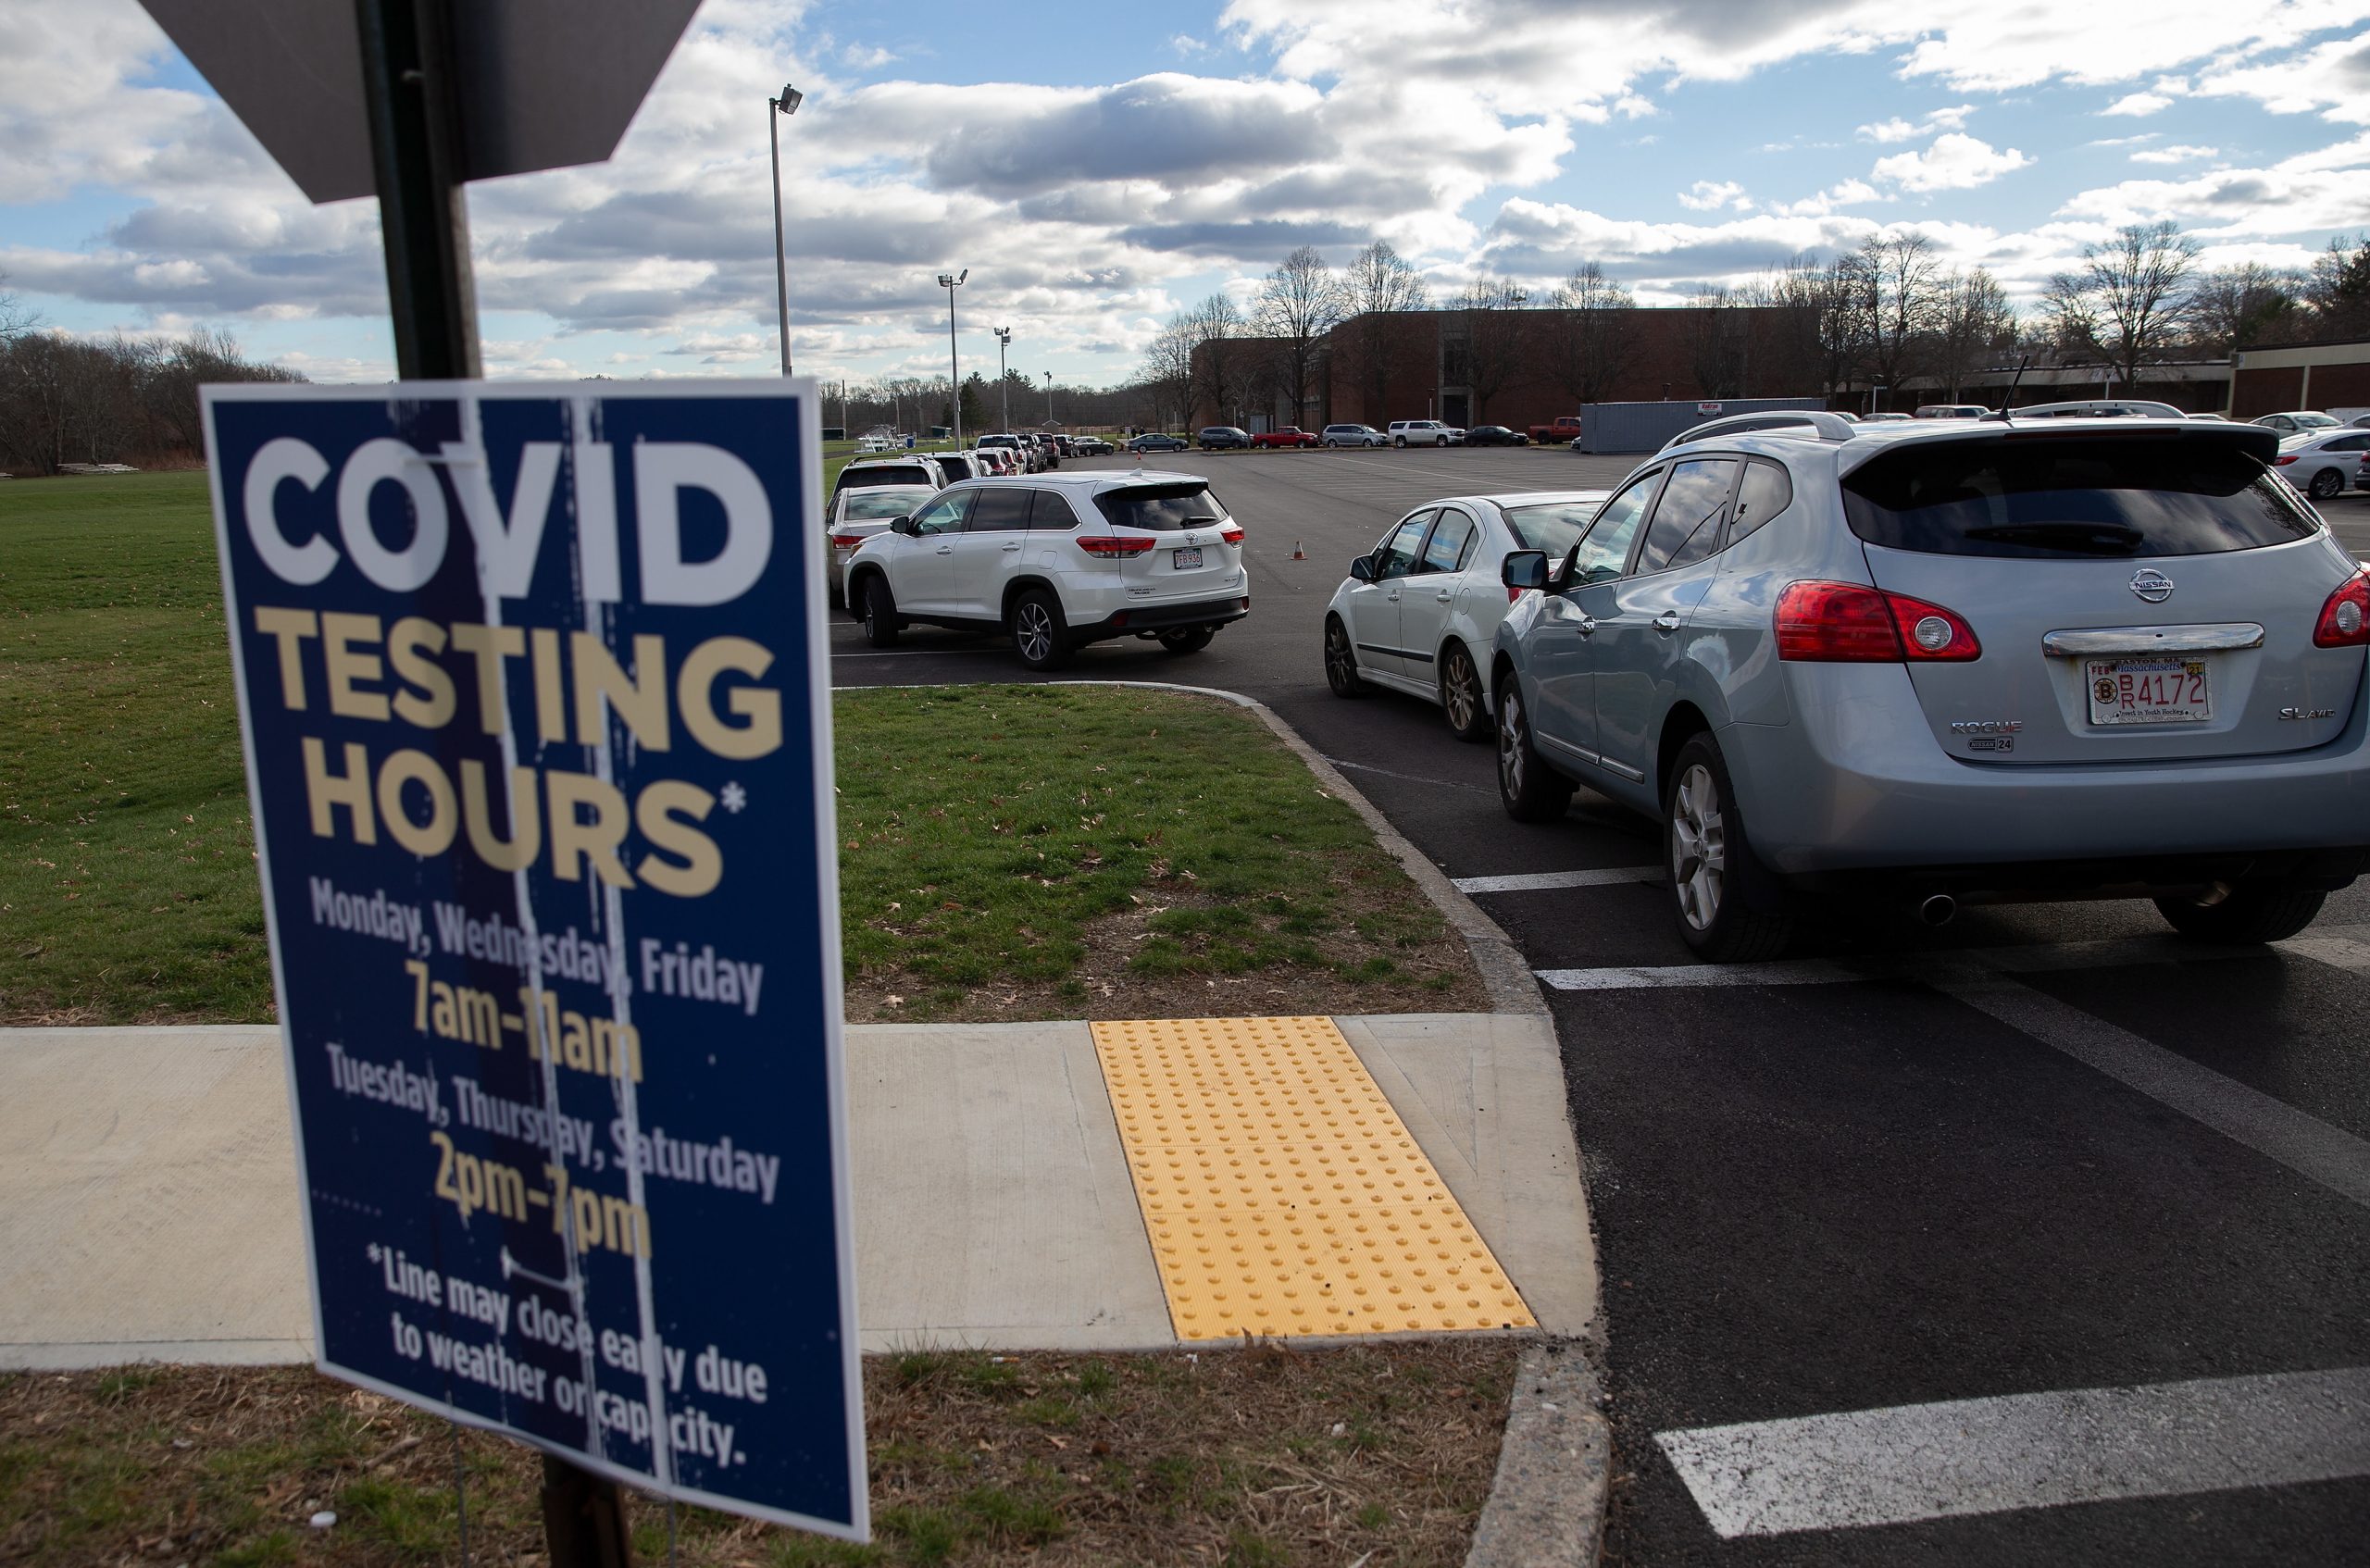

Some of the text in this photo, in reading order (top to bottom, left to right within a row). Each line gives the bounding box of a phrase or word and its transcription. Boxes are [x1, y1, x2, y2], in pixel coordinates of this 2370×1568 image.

[243, 436, 773, 606] COVID
[2091, 666, 2110, 675] FEB
[2116, 663, 2181, 673] Massachusetts
[2190, 666, 2201, 674] 21
[255, 605, 783, 760] TESTING
[2138, 675, 2203, 705] 4172
[2162, 707, 2184, 716] Hockey
[2278, 707, 2305, 719] SL
[1951, 720, 2022, 734] ROGUE
[1998, 740, 2011, 749] 24
[309, 876, 431, 957] Monday,
[640, 938, 764, 1015] Friday
[325, 1041, 780, 1203] Tuesday, Thursday, Saturday
[446, 1276, 510, 1336] may
[518, 1294, 595, 1356] close
[695, 1344, 768, 1403] due
[392, 1312, 746, 1468] to weather or capcity.
